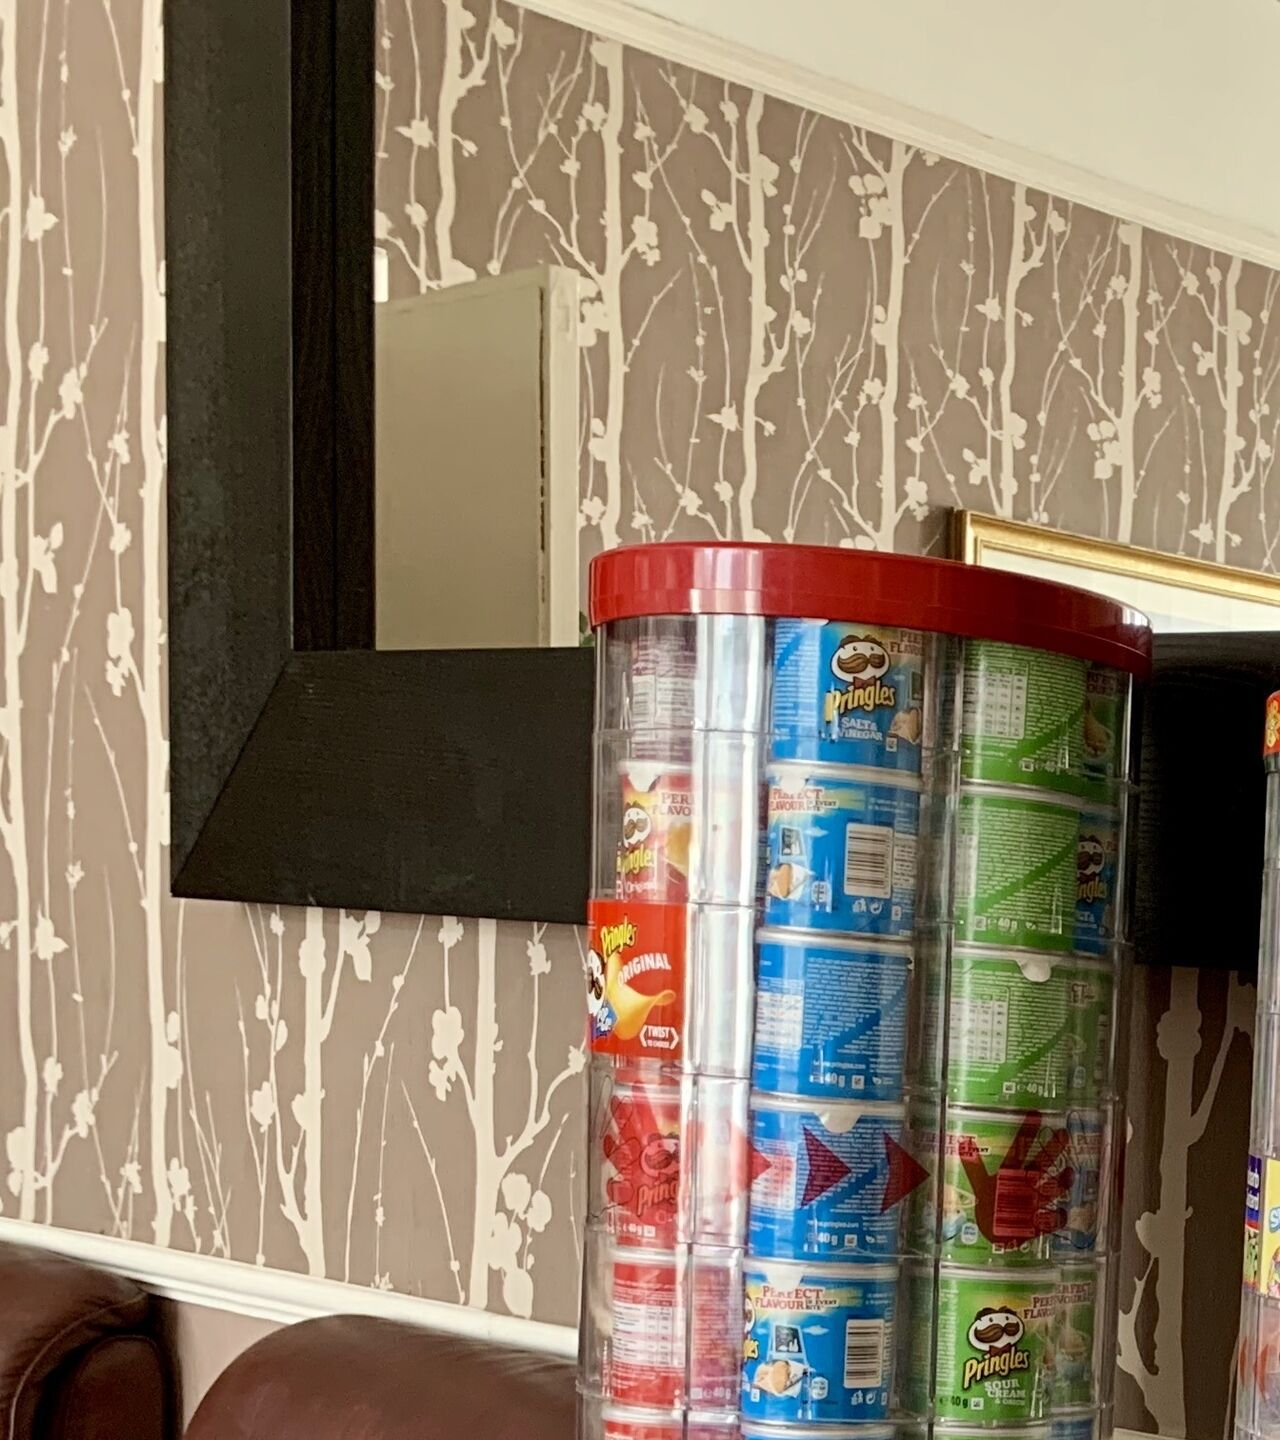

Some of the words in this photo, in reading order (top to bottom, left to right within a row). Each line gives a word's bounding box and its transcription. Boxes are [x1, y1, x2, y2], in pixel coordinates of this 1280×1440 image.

[825, 680, 895, 724] Pringles
[601, 915, 637, 962] Pringles
[618, 952, 671, 987] ORIGINAL
[756, 1299, 805, 1310] FLAVOUR
[964, 1346, 1029, 1390] Pringles
[984, 1379, 1020, 1391] SOUR
